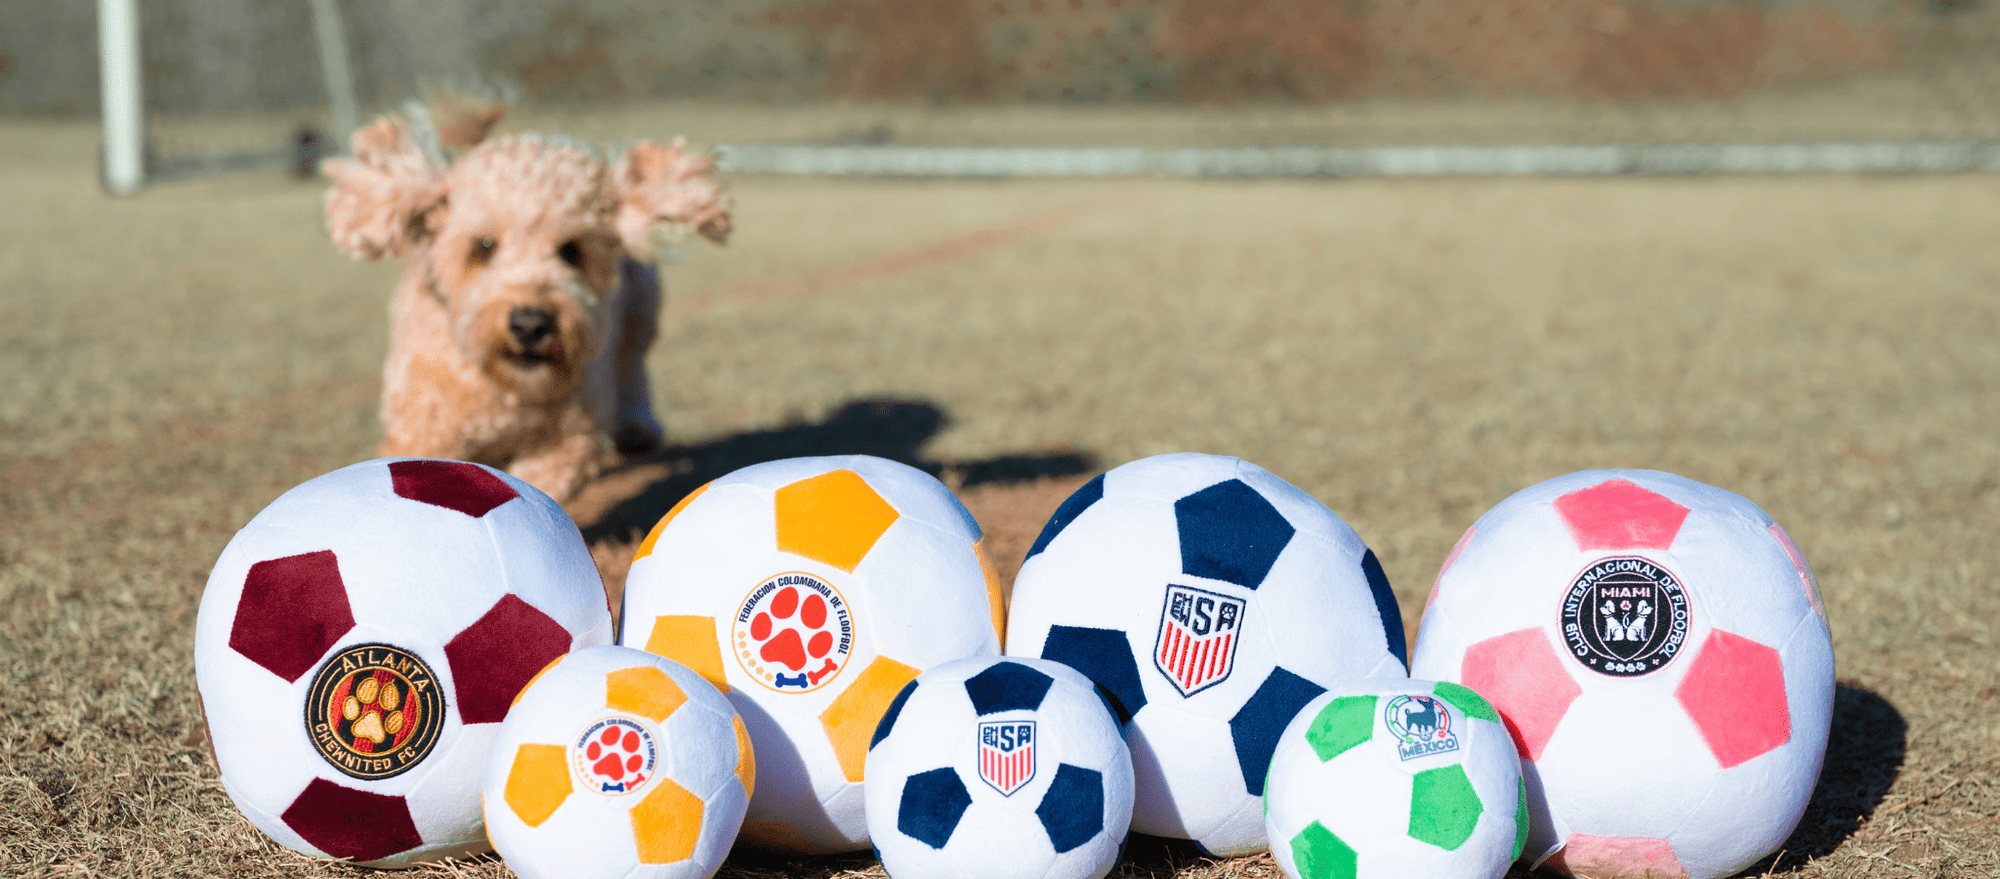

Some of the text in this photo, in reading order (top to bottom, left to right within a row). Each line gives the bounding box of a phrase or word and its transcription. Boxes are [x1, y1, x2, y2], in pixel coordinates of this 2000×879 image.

[738, 576, 851, 655] FEDERACION COLOMBIANA DE FLOOFBOL
[1565, 561, 1686, 658] CLUB INTERNACIONAL DE FLOOFBOL
[1601, 587, 1651, 598] MIAMI
[341, 650, 430, 692] ATLANTA
[315, 723, 416, 772] CHEWNITED FC
